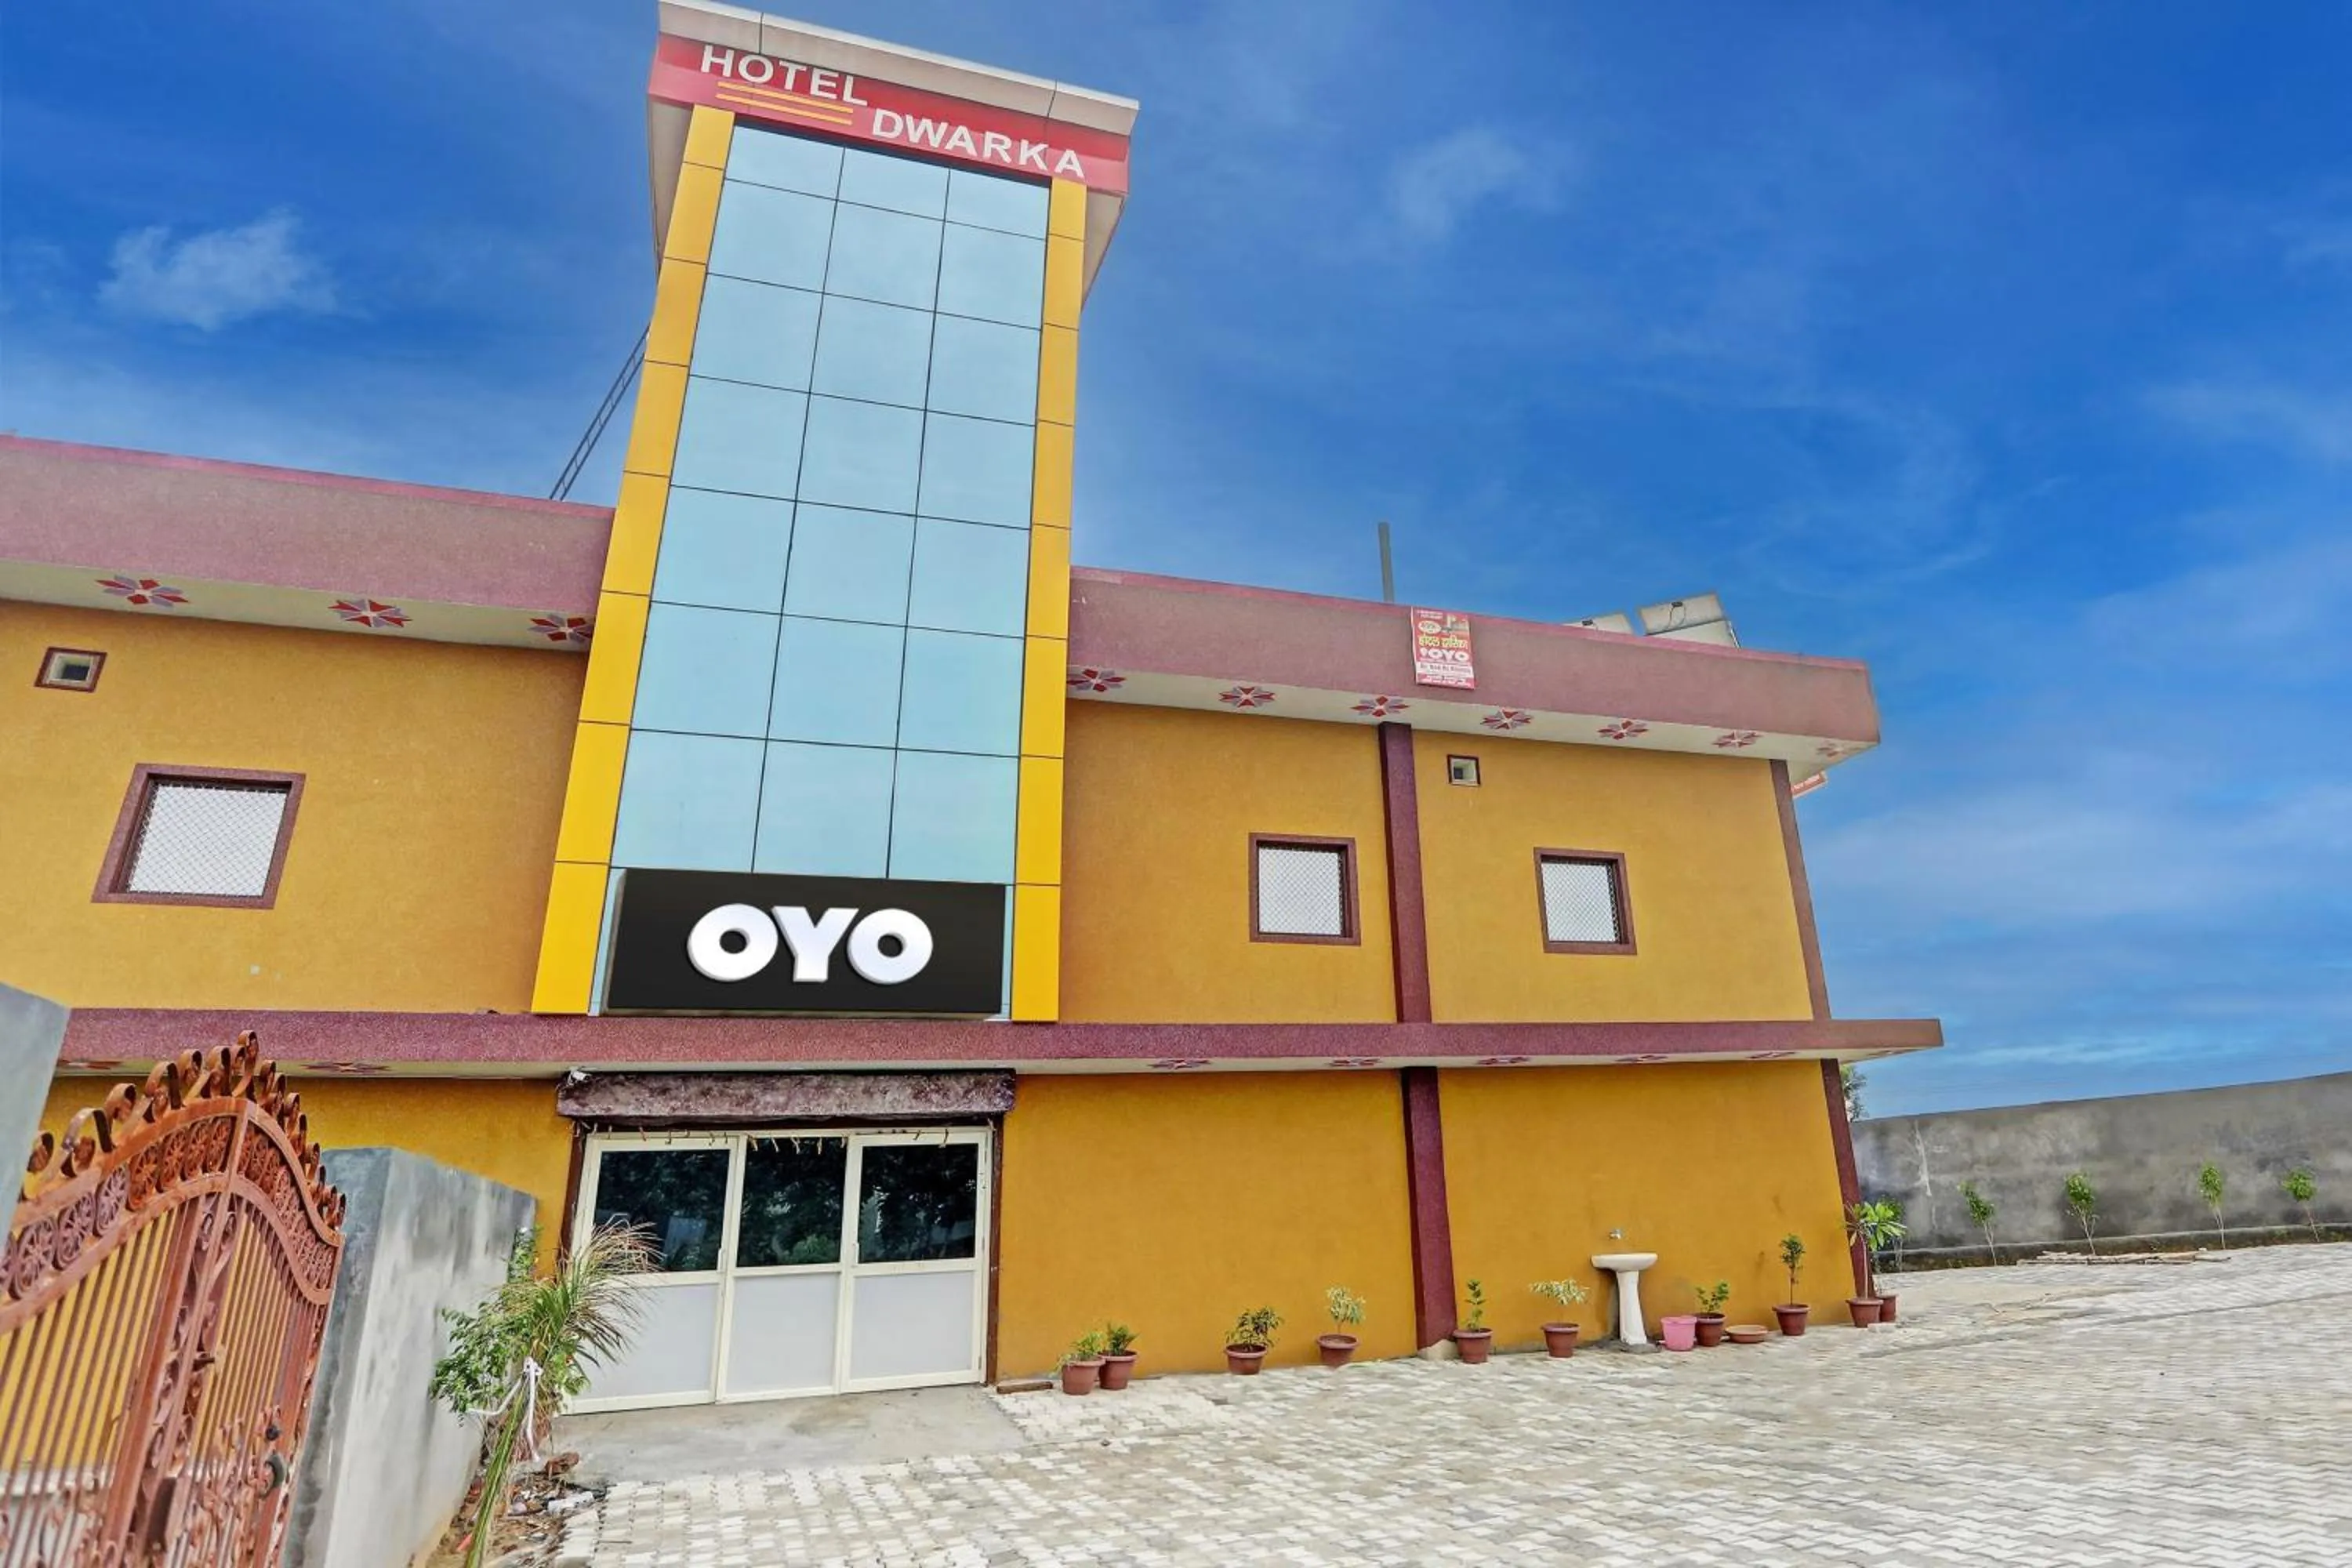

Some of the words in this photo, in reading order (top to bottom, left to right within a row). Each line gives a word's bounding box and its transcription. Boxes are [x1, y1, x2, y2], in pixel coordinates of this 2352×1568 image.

[700, 45, 868, 107] HOTEL
[871, 108, 1085, 179] DWARKA
[1428, 648, 1468, 662] OYO
[686, 903, 934, 985] OYO
